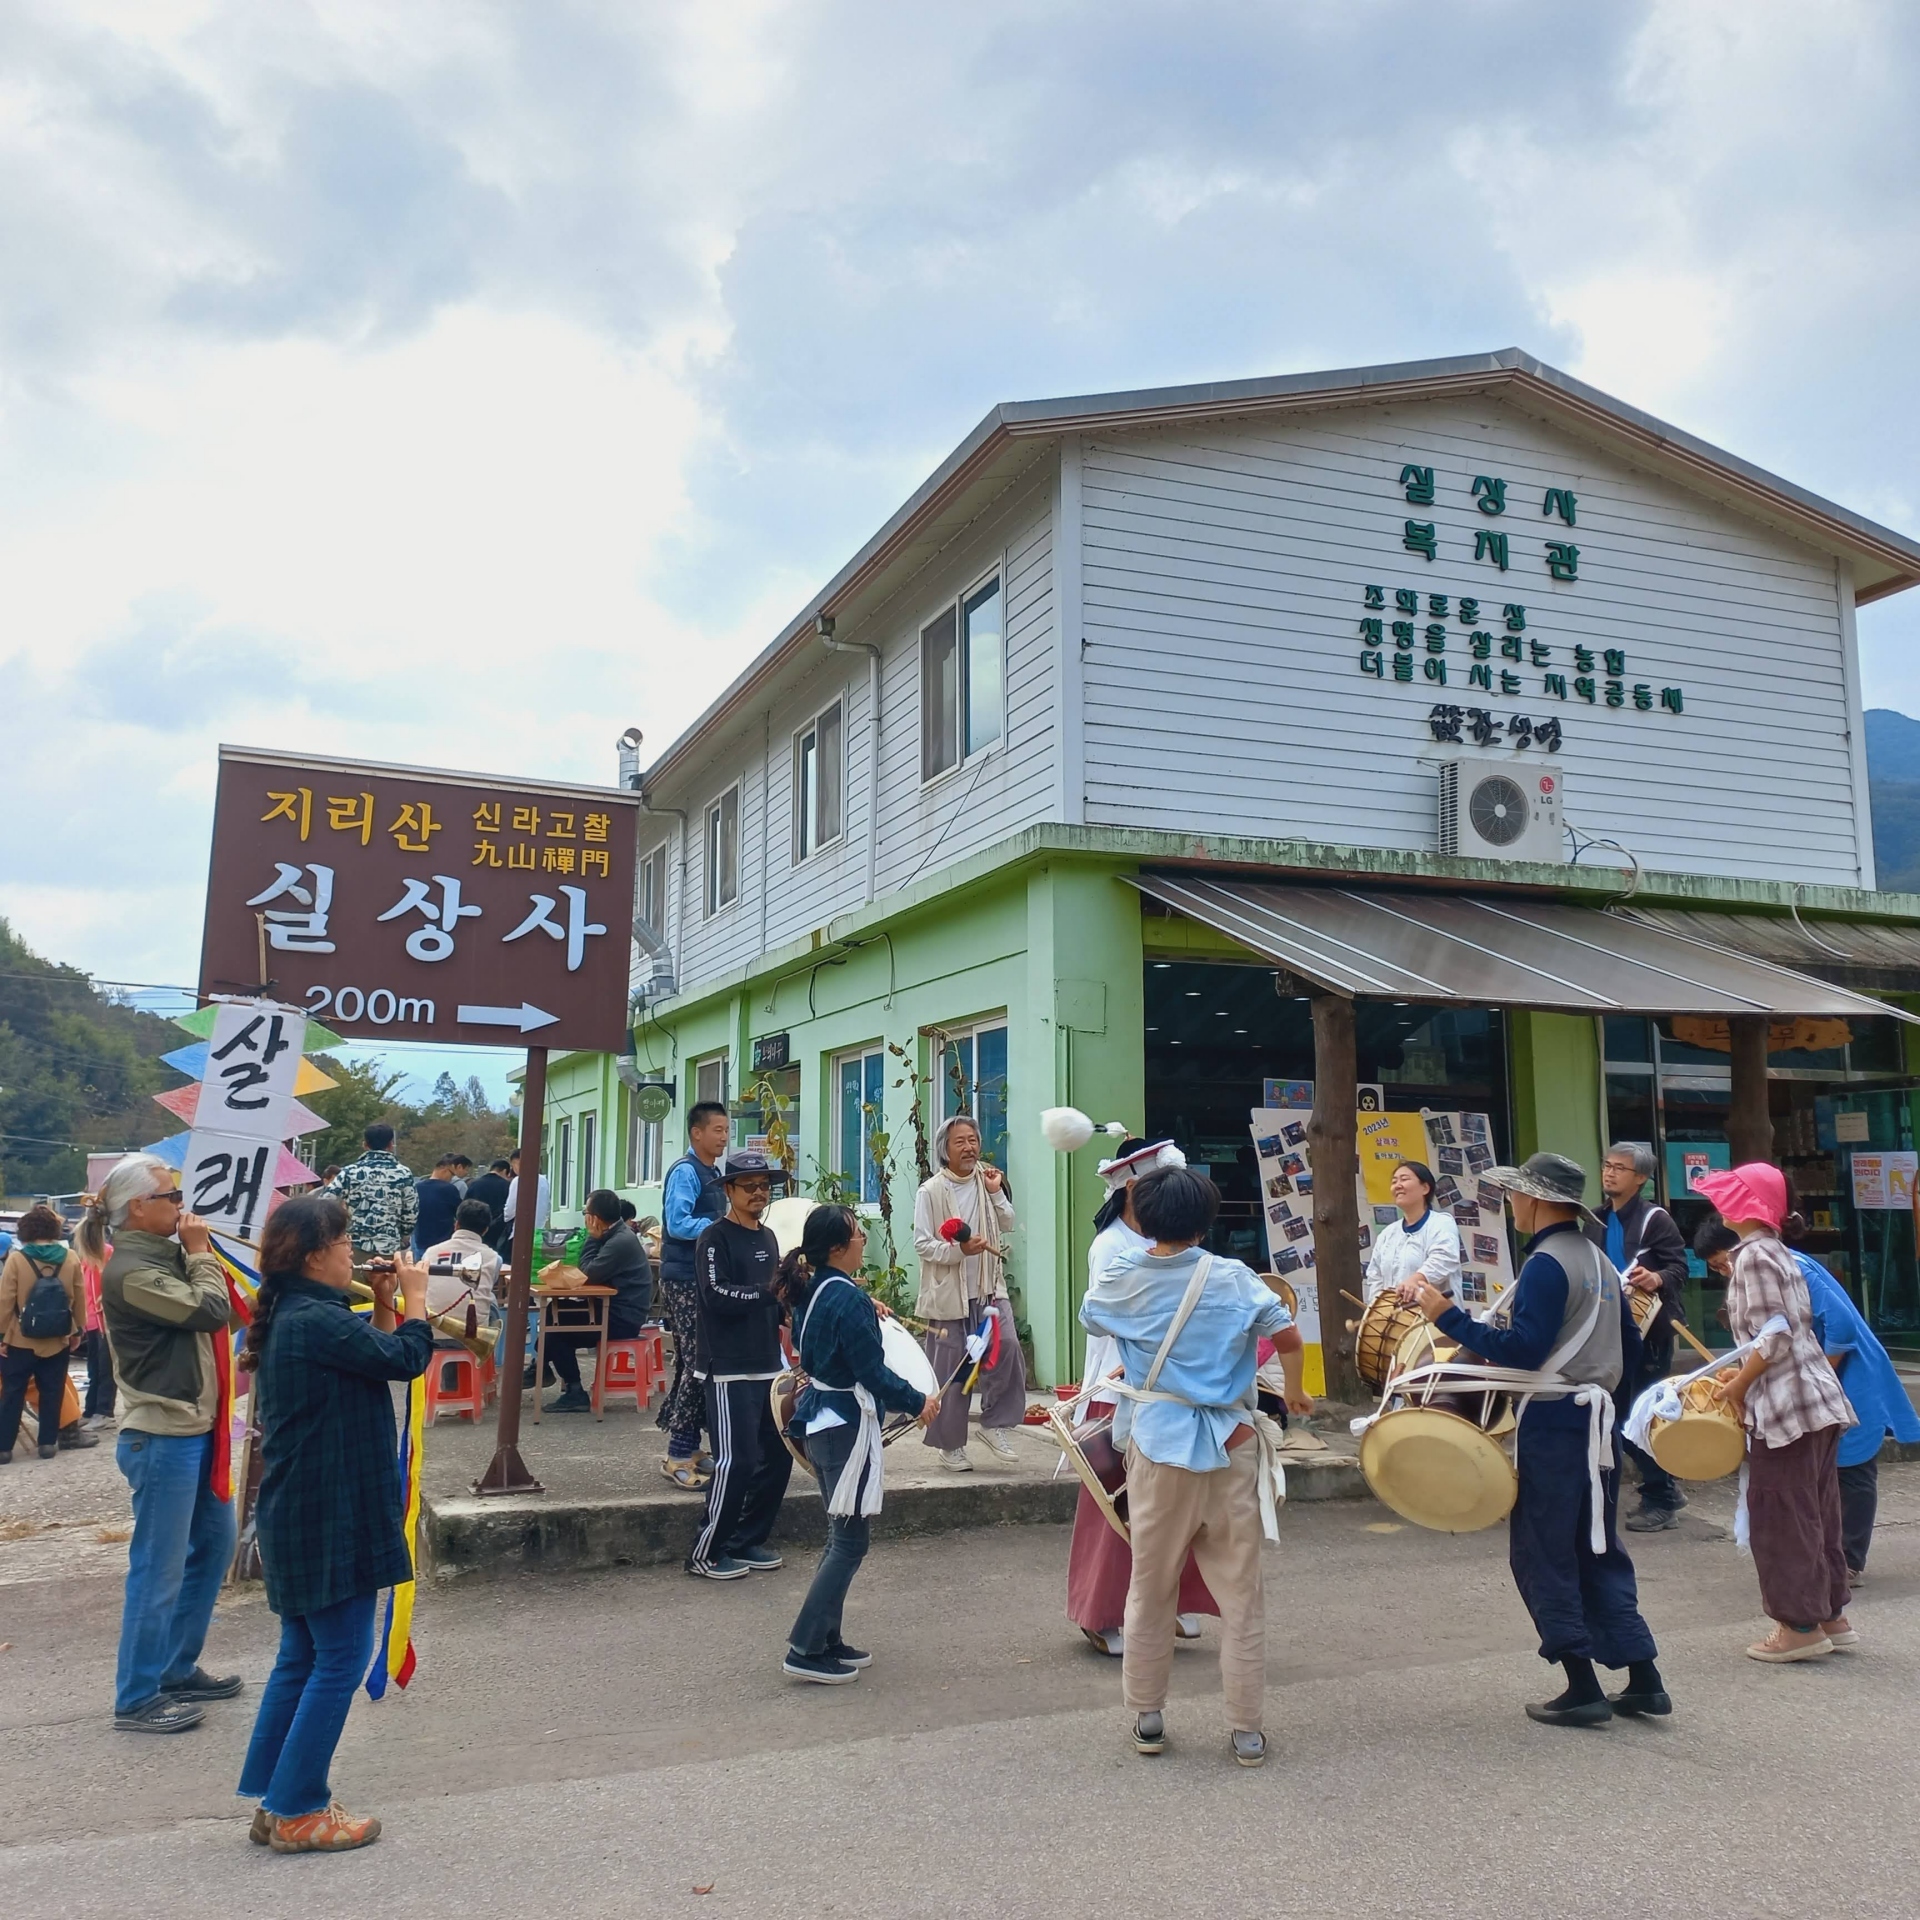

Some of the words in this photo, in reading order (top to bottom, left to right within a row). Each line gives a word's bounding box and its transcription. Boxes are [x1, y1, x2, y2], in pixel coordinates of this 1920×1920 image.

[1400, 464, 1578, 526] 실상사
[1403, 520, 1580, 581] 복지관
[1364, 584, 1480, 624] 조화로운
[1503, 603, 1526, 630] 삶
[1360, 617, 1446, 654] 생명을
[1470, 631, 1551, 667] 살리는
[1575, 644, 1625, 676] 농업
[1360, 650, 1446, 686] 더불어
[1470, 664, 1521, 694] 사는
[1544, 673, 1684, 713] 지역공동체
[261, 787, 442, 852] 지리산
[472, 802, 611, 843] 신라고찰
[1541, 796, 1553, 805] LG
[472, 839, 610, 878] 九山禪門
[246, 862, 607, 972] 실상사
[305, 985, 435, 1025] 200m
[1363, 1117, 1389, 1135] 2023년
